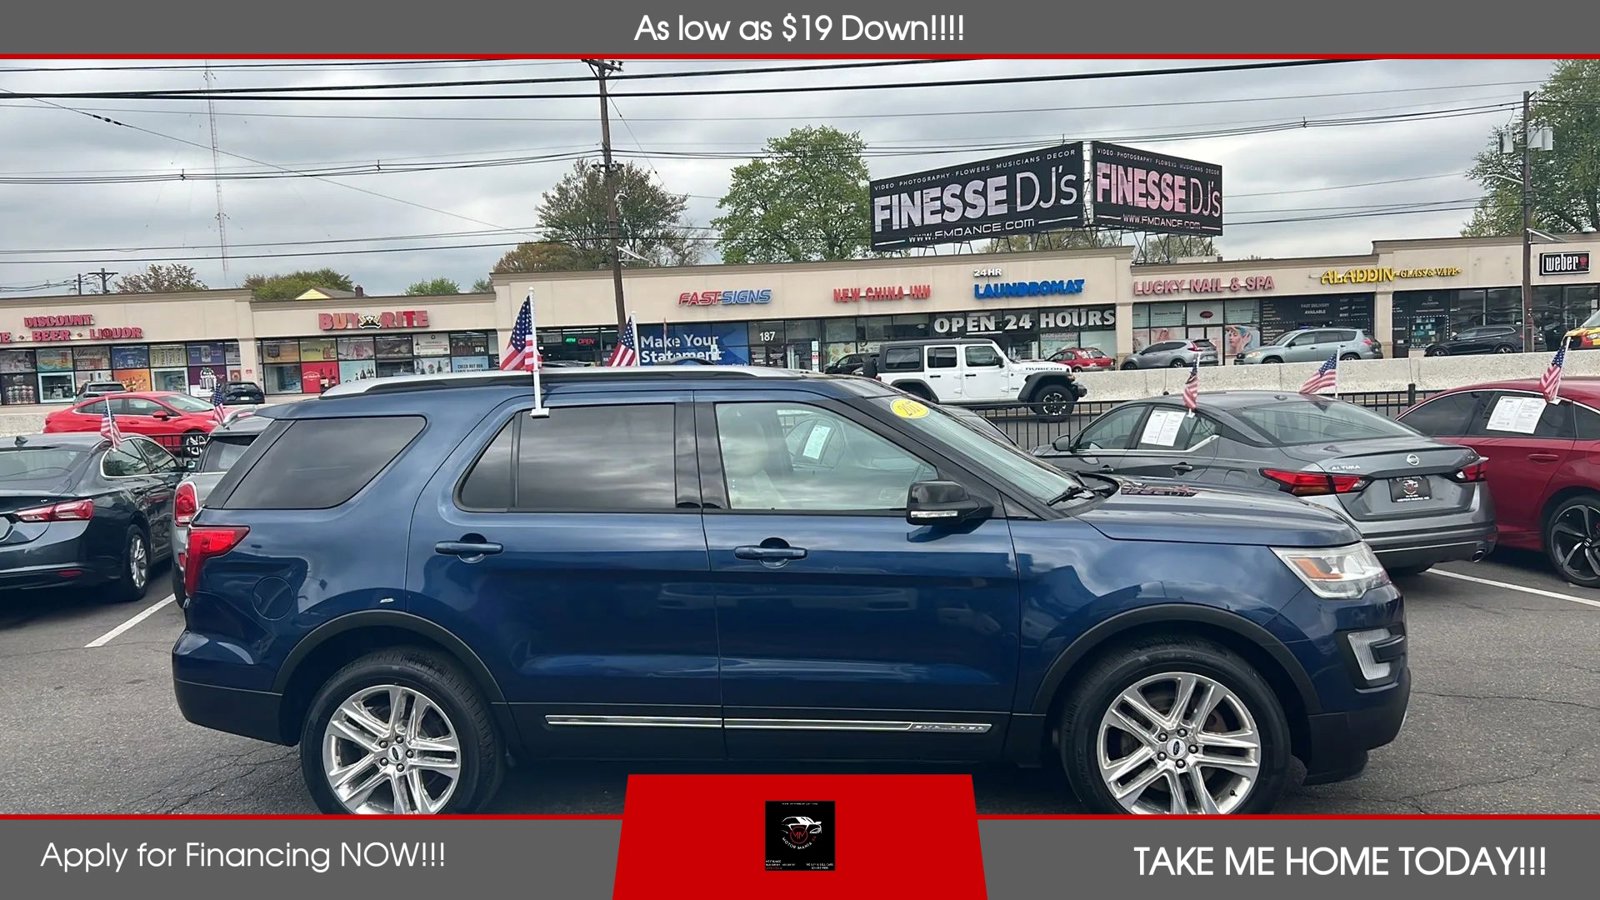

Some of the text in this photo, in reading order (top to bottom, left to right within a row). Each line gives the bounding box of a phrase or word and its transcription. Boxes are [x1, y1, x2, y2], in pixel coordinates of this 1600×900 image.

[1097, 148, 1114, 156] VIDEO
[1117, 152, 1153, 163] PHOTOGRAPHY
[874, 149, 1075, 191] VIDEO PHOTOGRAPHY FLOWERS MUSICIANS DECOR
[1096, 161, 1221, 217] FINESSE DJ's
[874, 165, 1078, 232] FINESSE DJ's
[1545, 253, 1579, 272] weber
[1320, 267, 1395, 285] ALADDIN
[833, 285, 931, 303] NEW CHINA INN
[974, 279, 1085, 300] LAUNDROMAT
[1134, 275, 1275, 296] LUCKY NAIL & SPA
[678, 289, 771, 305] FASTSIGNS
[24, 314, 95, 328] DISCOUNT
[318, 311, 429, 331] BUY RITE
[934, 309, 1116, 333] OPEN 24 HOURS
[32, 330, 71, 341] BEER
[90, 328, 144, 340] LIQUOR
[640, 334, 719, 348] Make Your
[760, 332, 776, 342] 187
